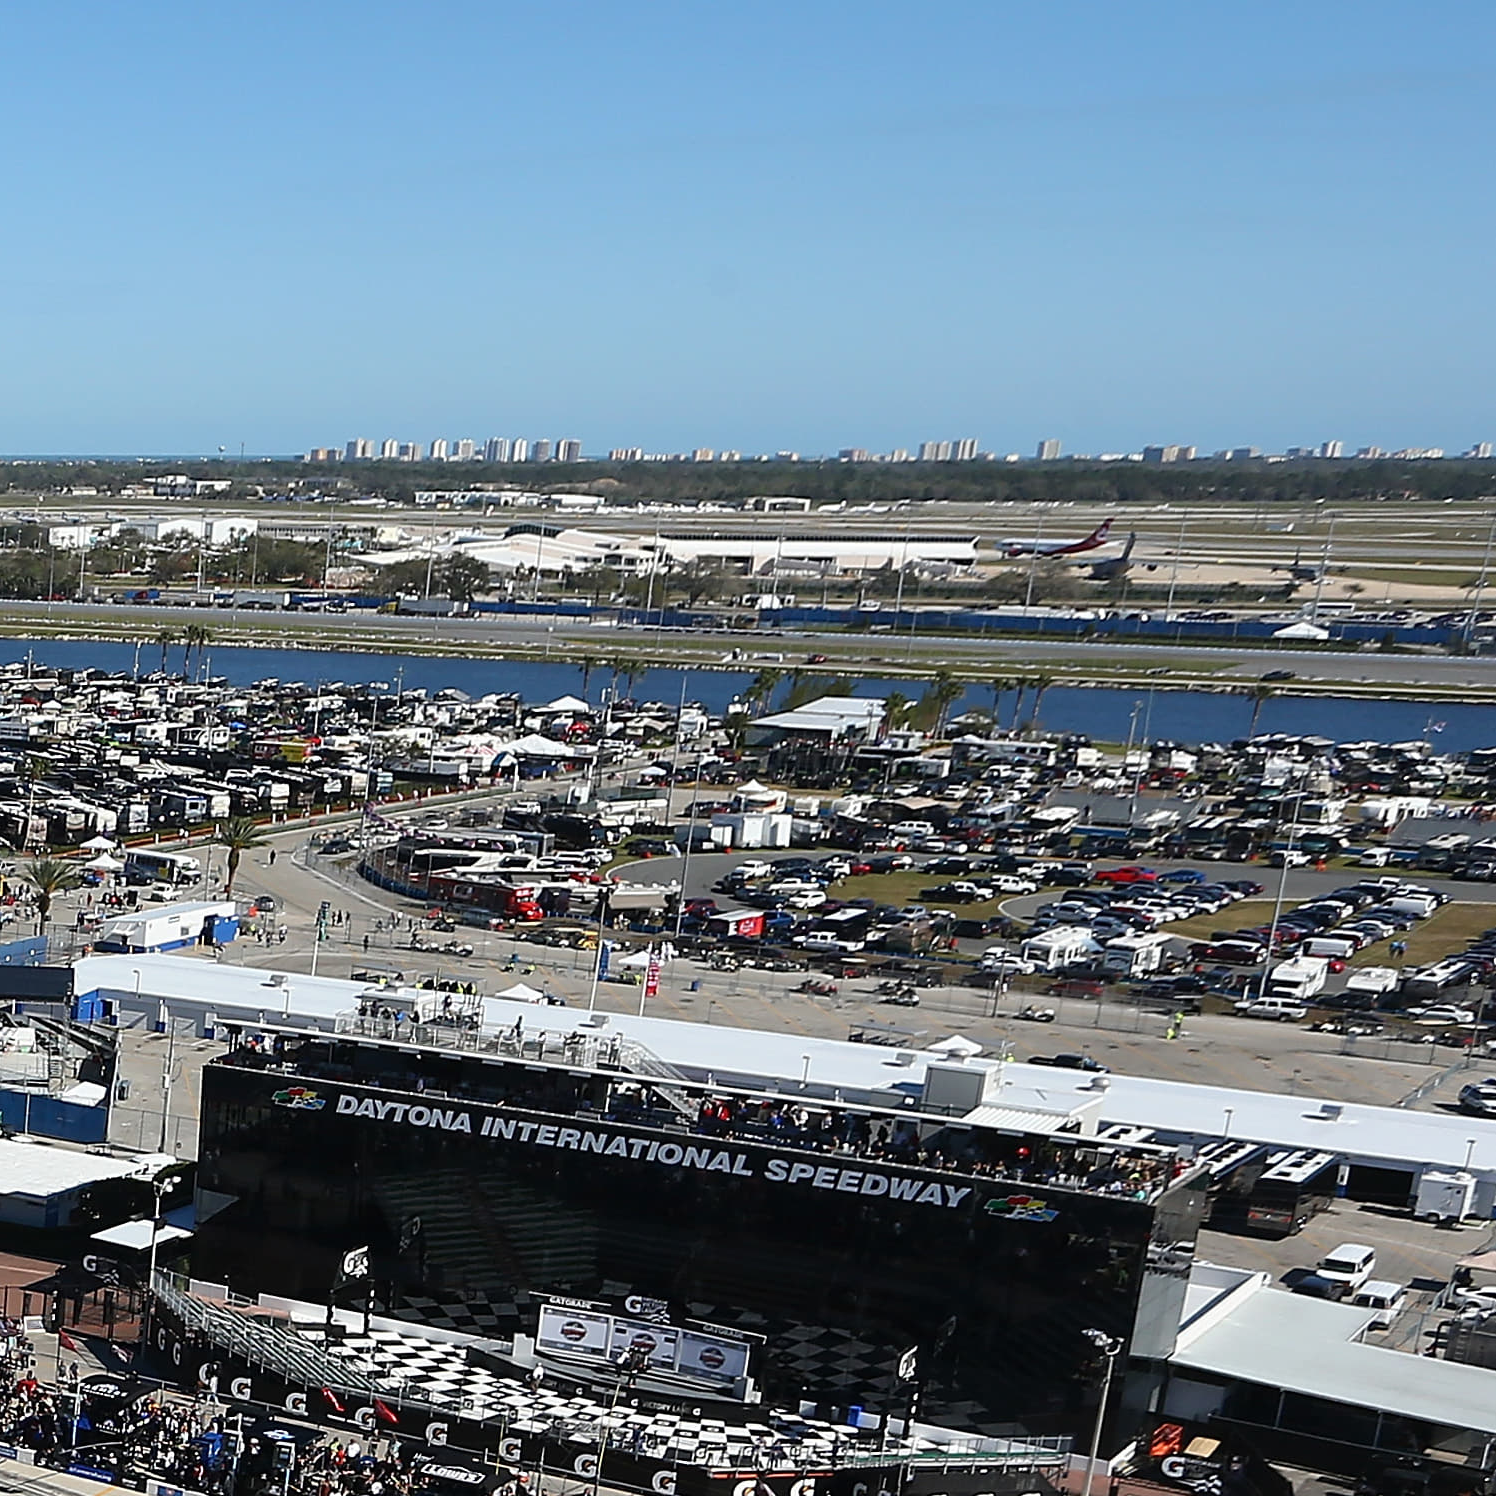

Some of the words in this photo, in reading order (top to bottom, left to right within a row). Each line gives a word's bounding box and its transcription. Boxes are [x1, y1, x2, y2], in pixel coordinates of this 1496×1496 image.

[335, 1093, 473, 1135] DAYTONA
[480, 1115, 754, 1179] INTERNATIONAL
[764, 1158, 971, 1209] SPEEDWAY
[82, 1254, 98, 1272] G
[548, 1295, 592, 1310] GATORADE
[625, 1295, 643, 1314] G
[156, 1327, 167, 1352] G
[171, 1342, 182, 1366] G
[230, 1377, 252, 1400] G
[286, 1391, 307, 1415] G
[355, 1406, 377, 1430] G
[425, 1422, 448, 1446] G
[499, 1438, 523, 1462] G
[574, 1454, 598, 1479] G
[1161, 1456, 1185, 1478] G
[651, 1470, 677, 1496] G
